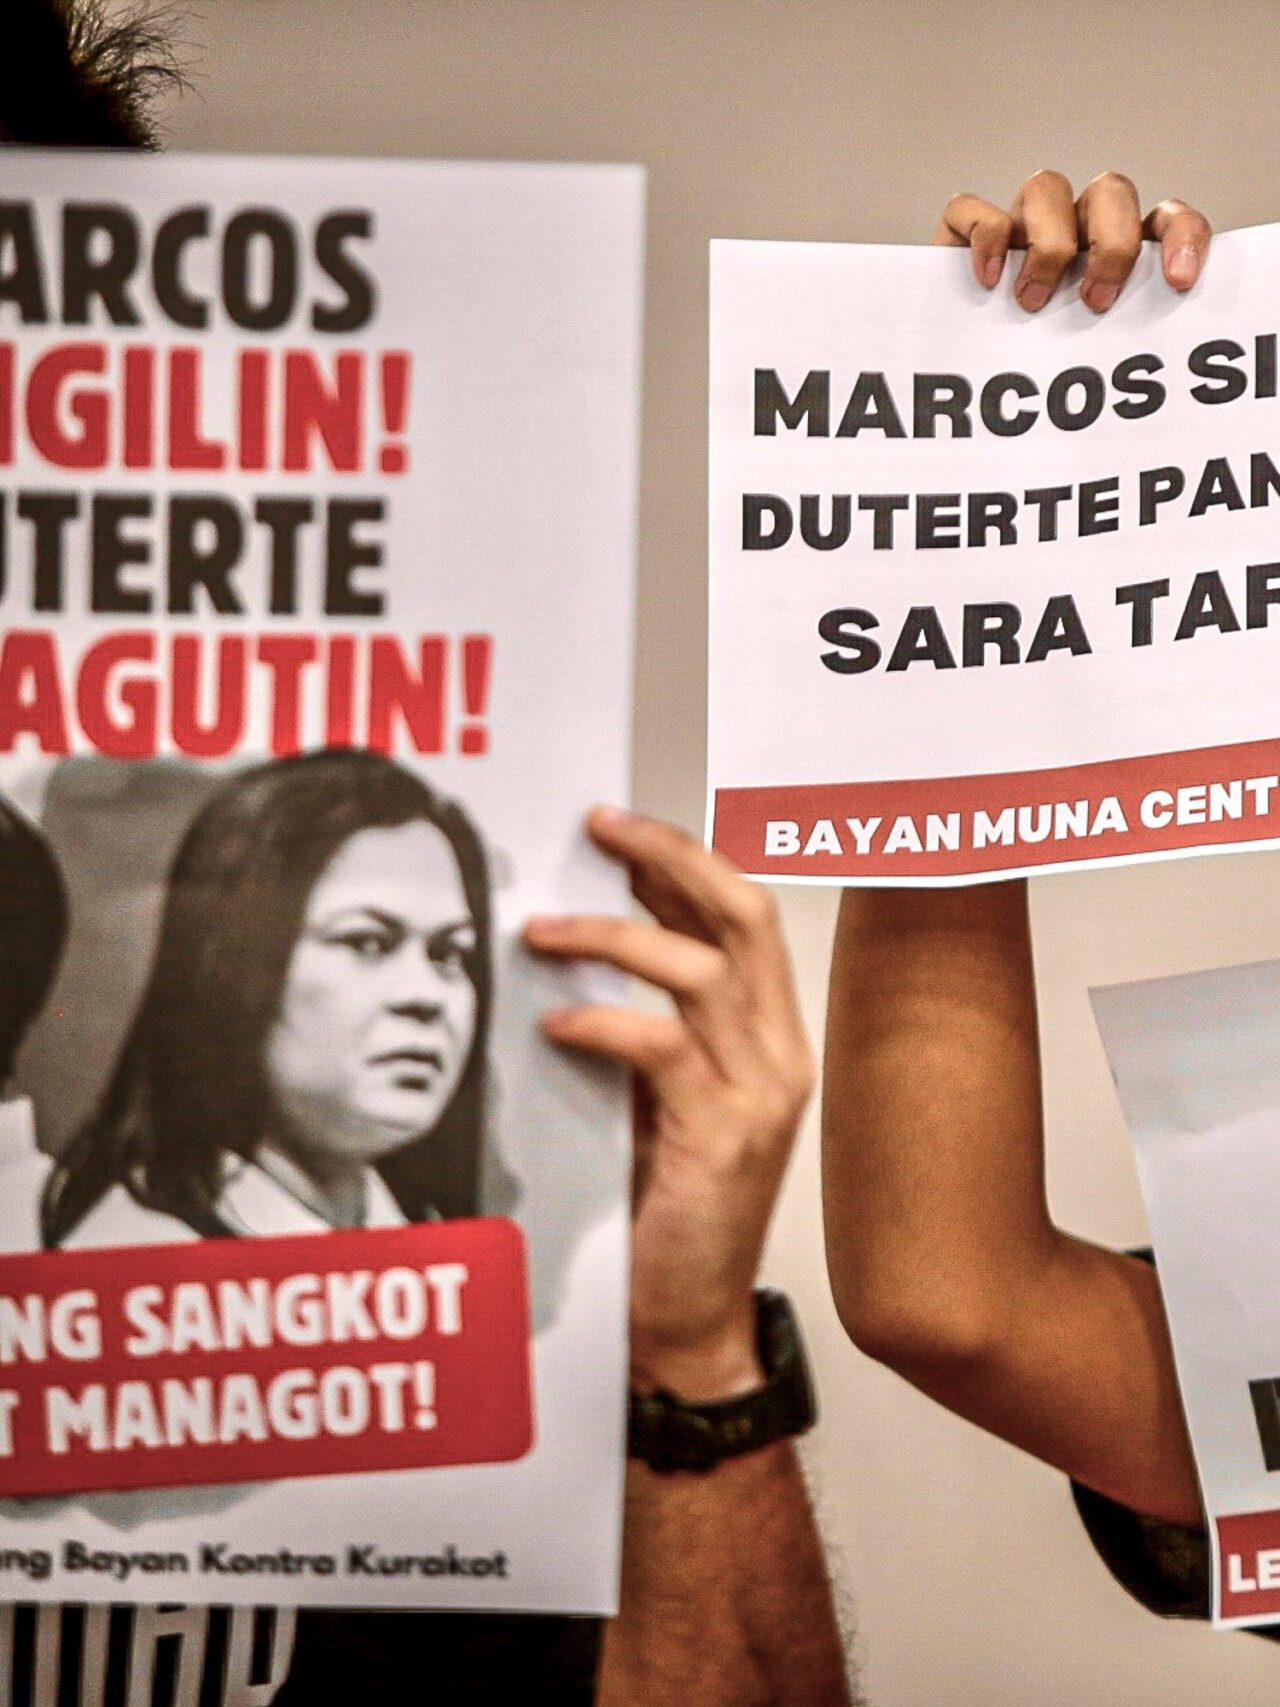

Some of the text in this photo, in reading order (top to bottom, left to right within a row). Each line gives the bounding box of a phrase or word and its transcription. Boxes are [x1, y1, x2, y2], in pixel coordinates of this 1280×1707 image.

[0, 341, 412, 475] GILIN!
[753, 353, 1167, 438] MARCOS
[0, 489, 388, 617] TERTE
[741, 476, 1120, 551] DUTERTE
[817, 594, 1093, 675] SARA
[0, 628, 493, 761] AGUTIN!
[764, 812, 961, 856] BAYAN
[972, 796, 1129, 849] MUNA
[0, 1262, 469, 1363] NG SANGKOT
[46, 1360, 438, 1454] MANAGOT!
[0, 1540, 508, 1581] ng Bayan Kontra Kurakot
